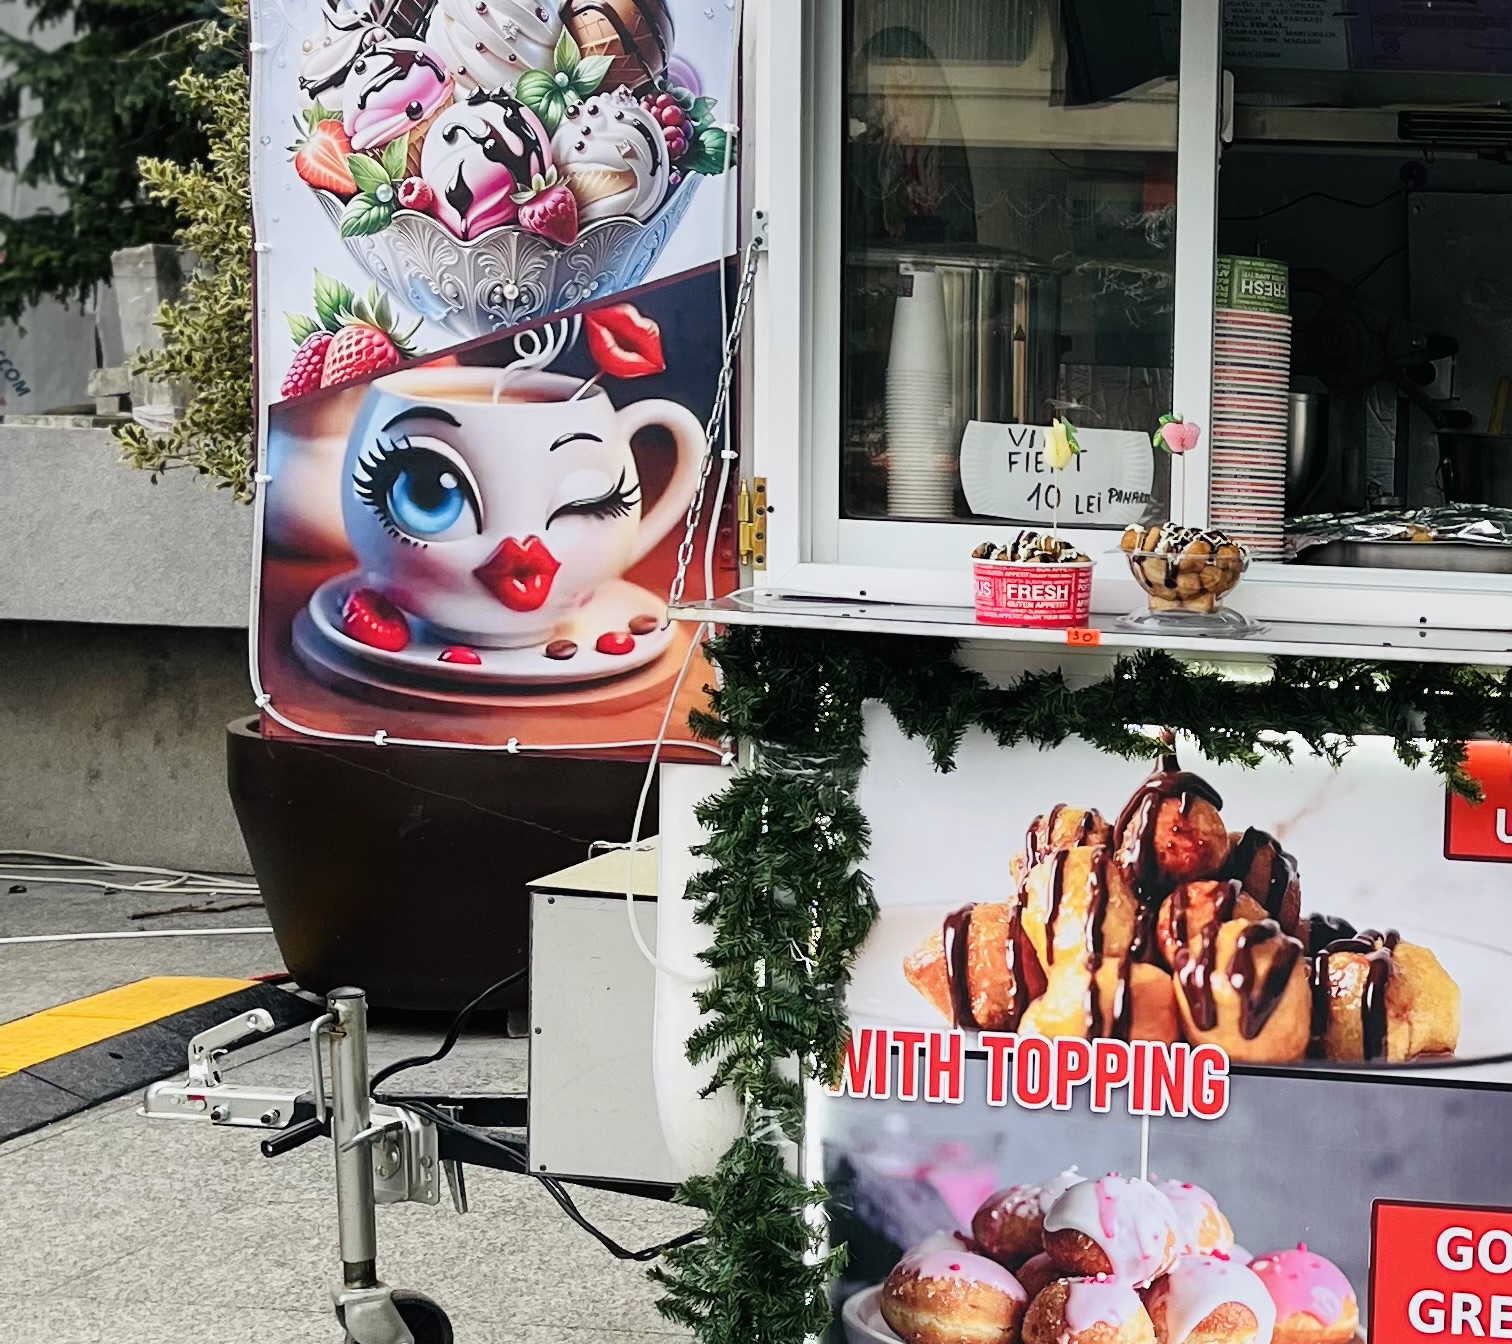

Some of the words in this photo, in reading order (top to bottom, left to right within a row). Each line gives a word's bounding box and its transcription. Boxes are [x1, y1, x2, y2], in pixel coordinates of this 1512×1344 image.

[1008, 450, 1088, 474] FIET
[1027, 482, 1061, 510] 10
[1007, 583, 1069, 600] FRESH
[828, 1029, 963, 1104] WITH
[980, 1032, 1229, 1119] TOPPING
